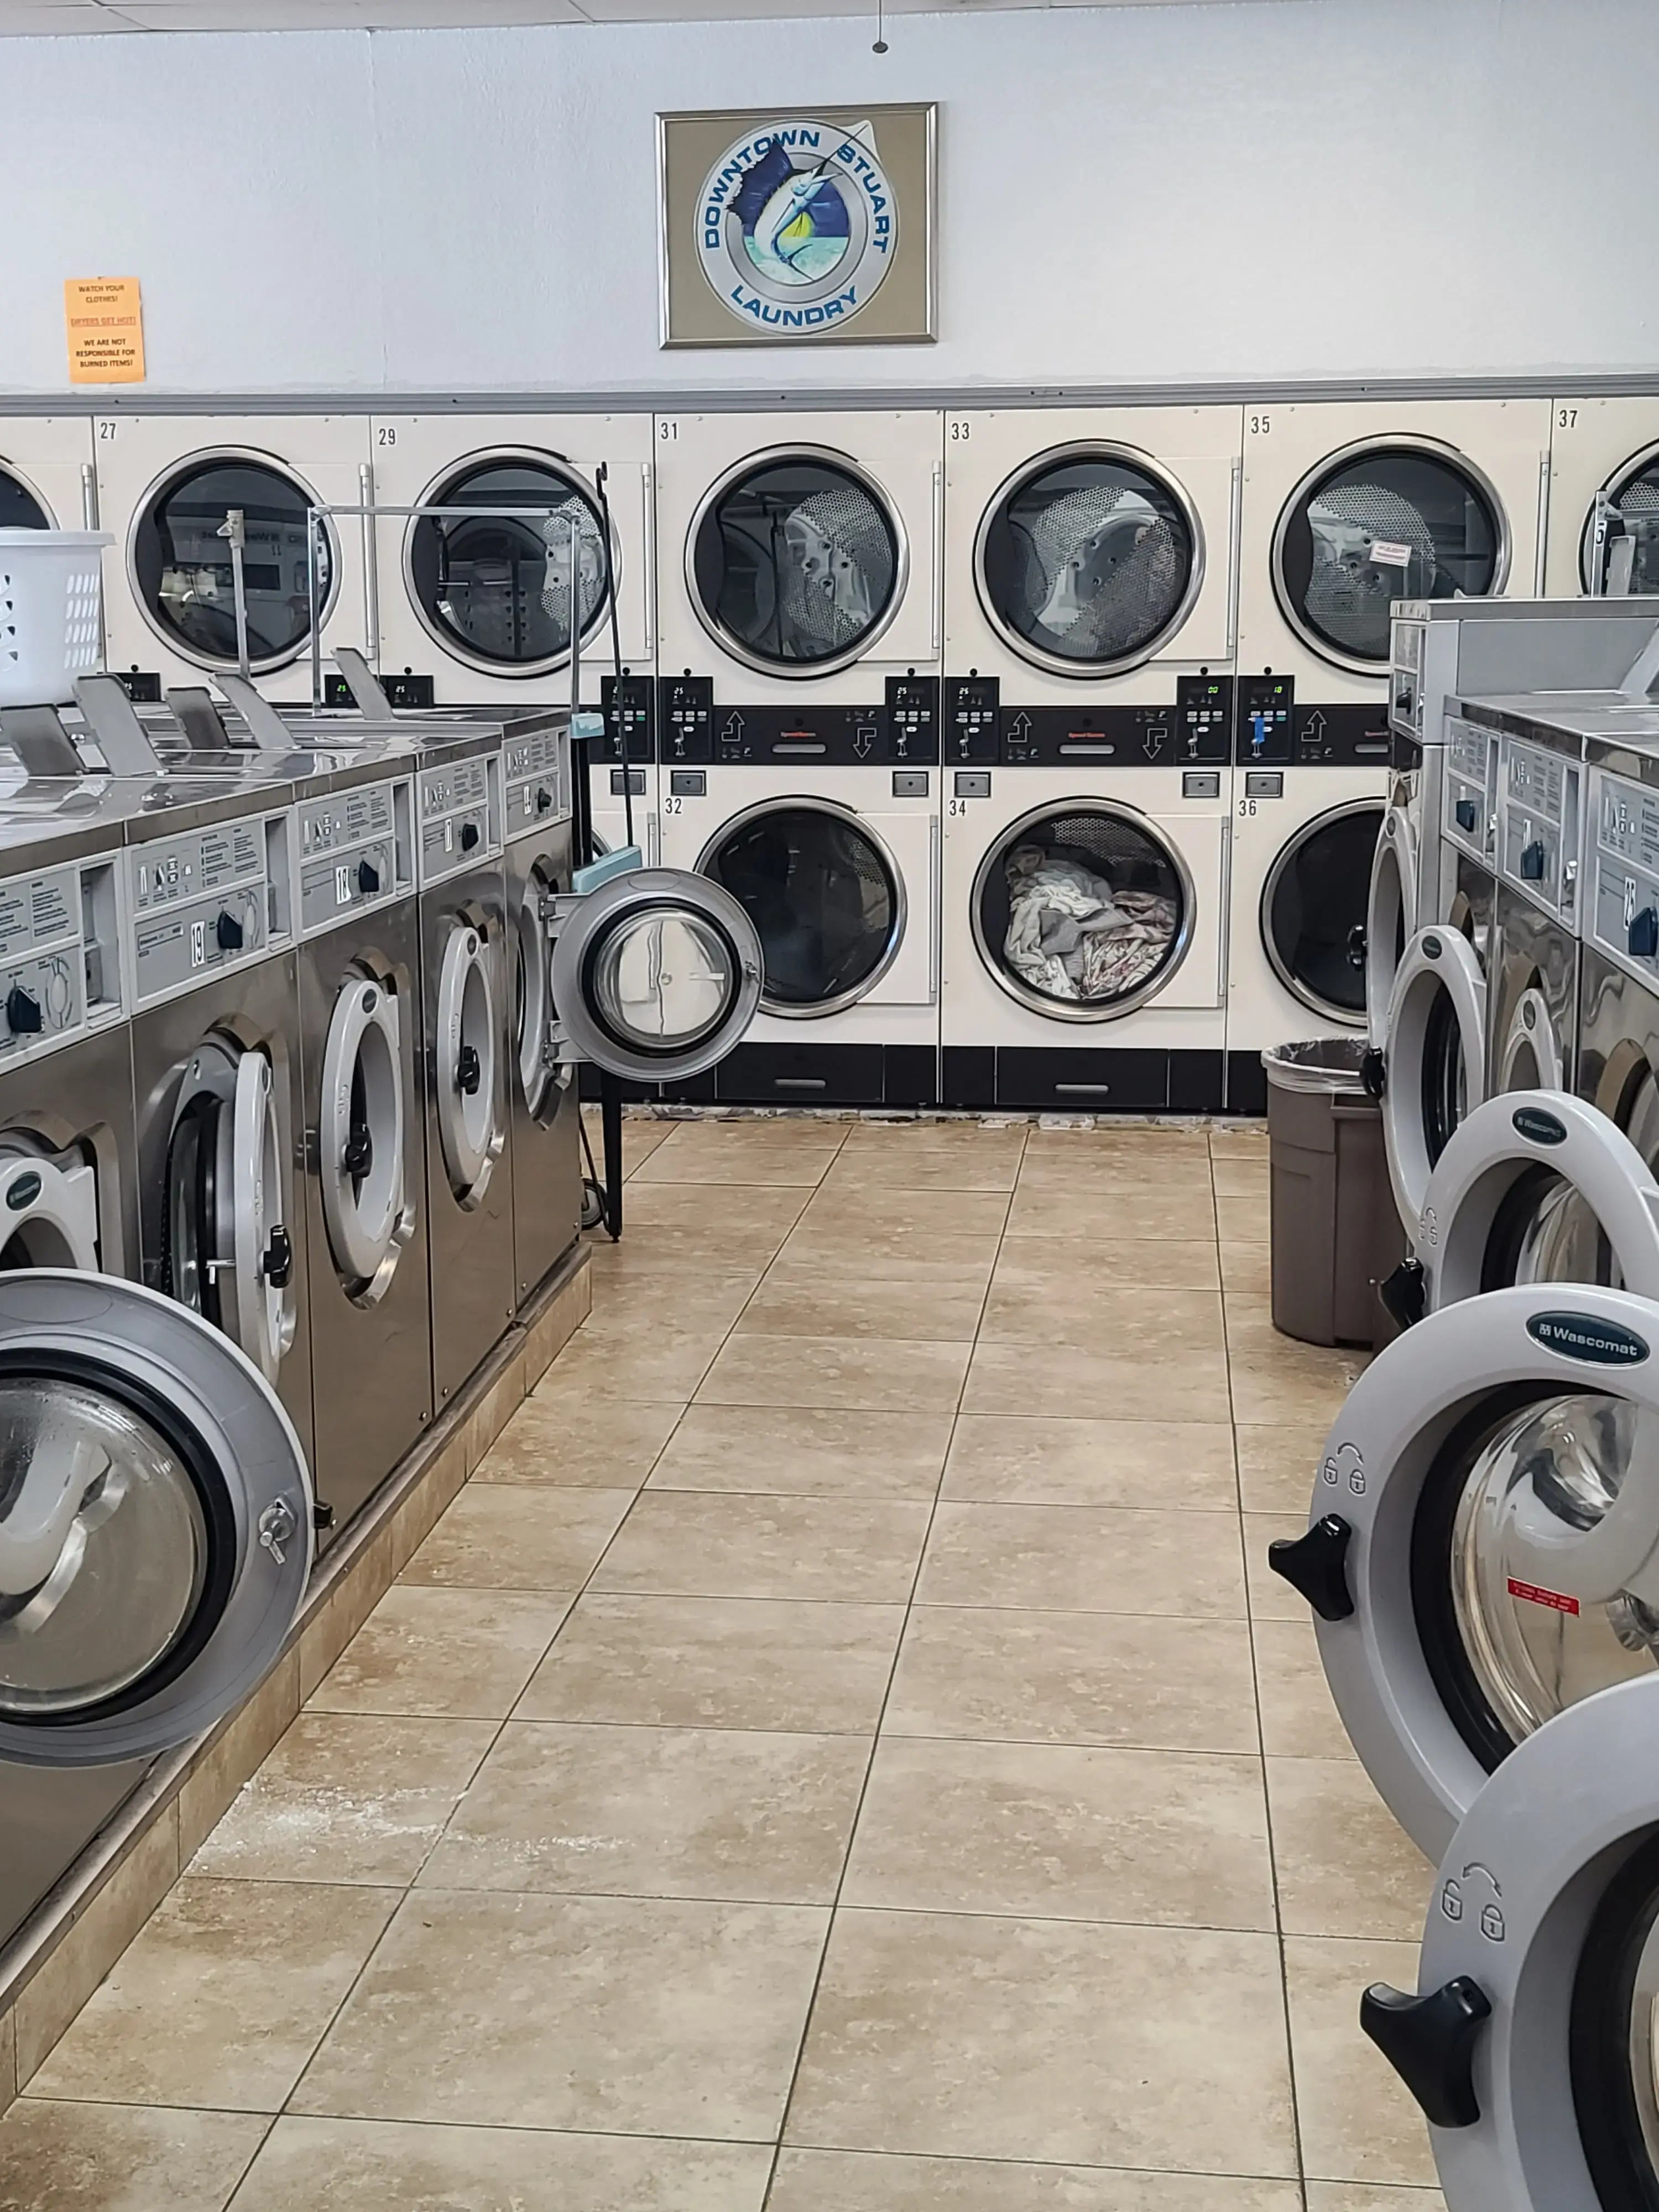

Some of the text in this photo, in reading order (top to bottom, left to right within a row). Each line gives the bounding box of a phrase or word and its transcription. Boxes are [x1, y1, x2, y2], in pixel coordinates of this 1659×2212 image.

[705, 129, 890, 253] DOWNTOWN STUART
[731, 285, 857, 326] LAUNDRY
[1251, 416, 1271, 434] 35
[1559, 409, 1578, 429] 37
[100, 422, 117, 440] 27
[379, 428, 396, 446] 29
[660, 422, 678, 440] 31
[951, 422, 970, 440] 33
[665, 798, 682, 814] 32
[950, 800, 966, 816] 34
[1239, 800, 1256, 816] 36
[338, 868, 347, 901] 18
[192, 925, 202, 963] 19
[1553, 1326, 1637, 1356] Wascomat
